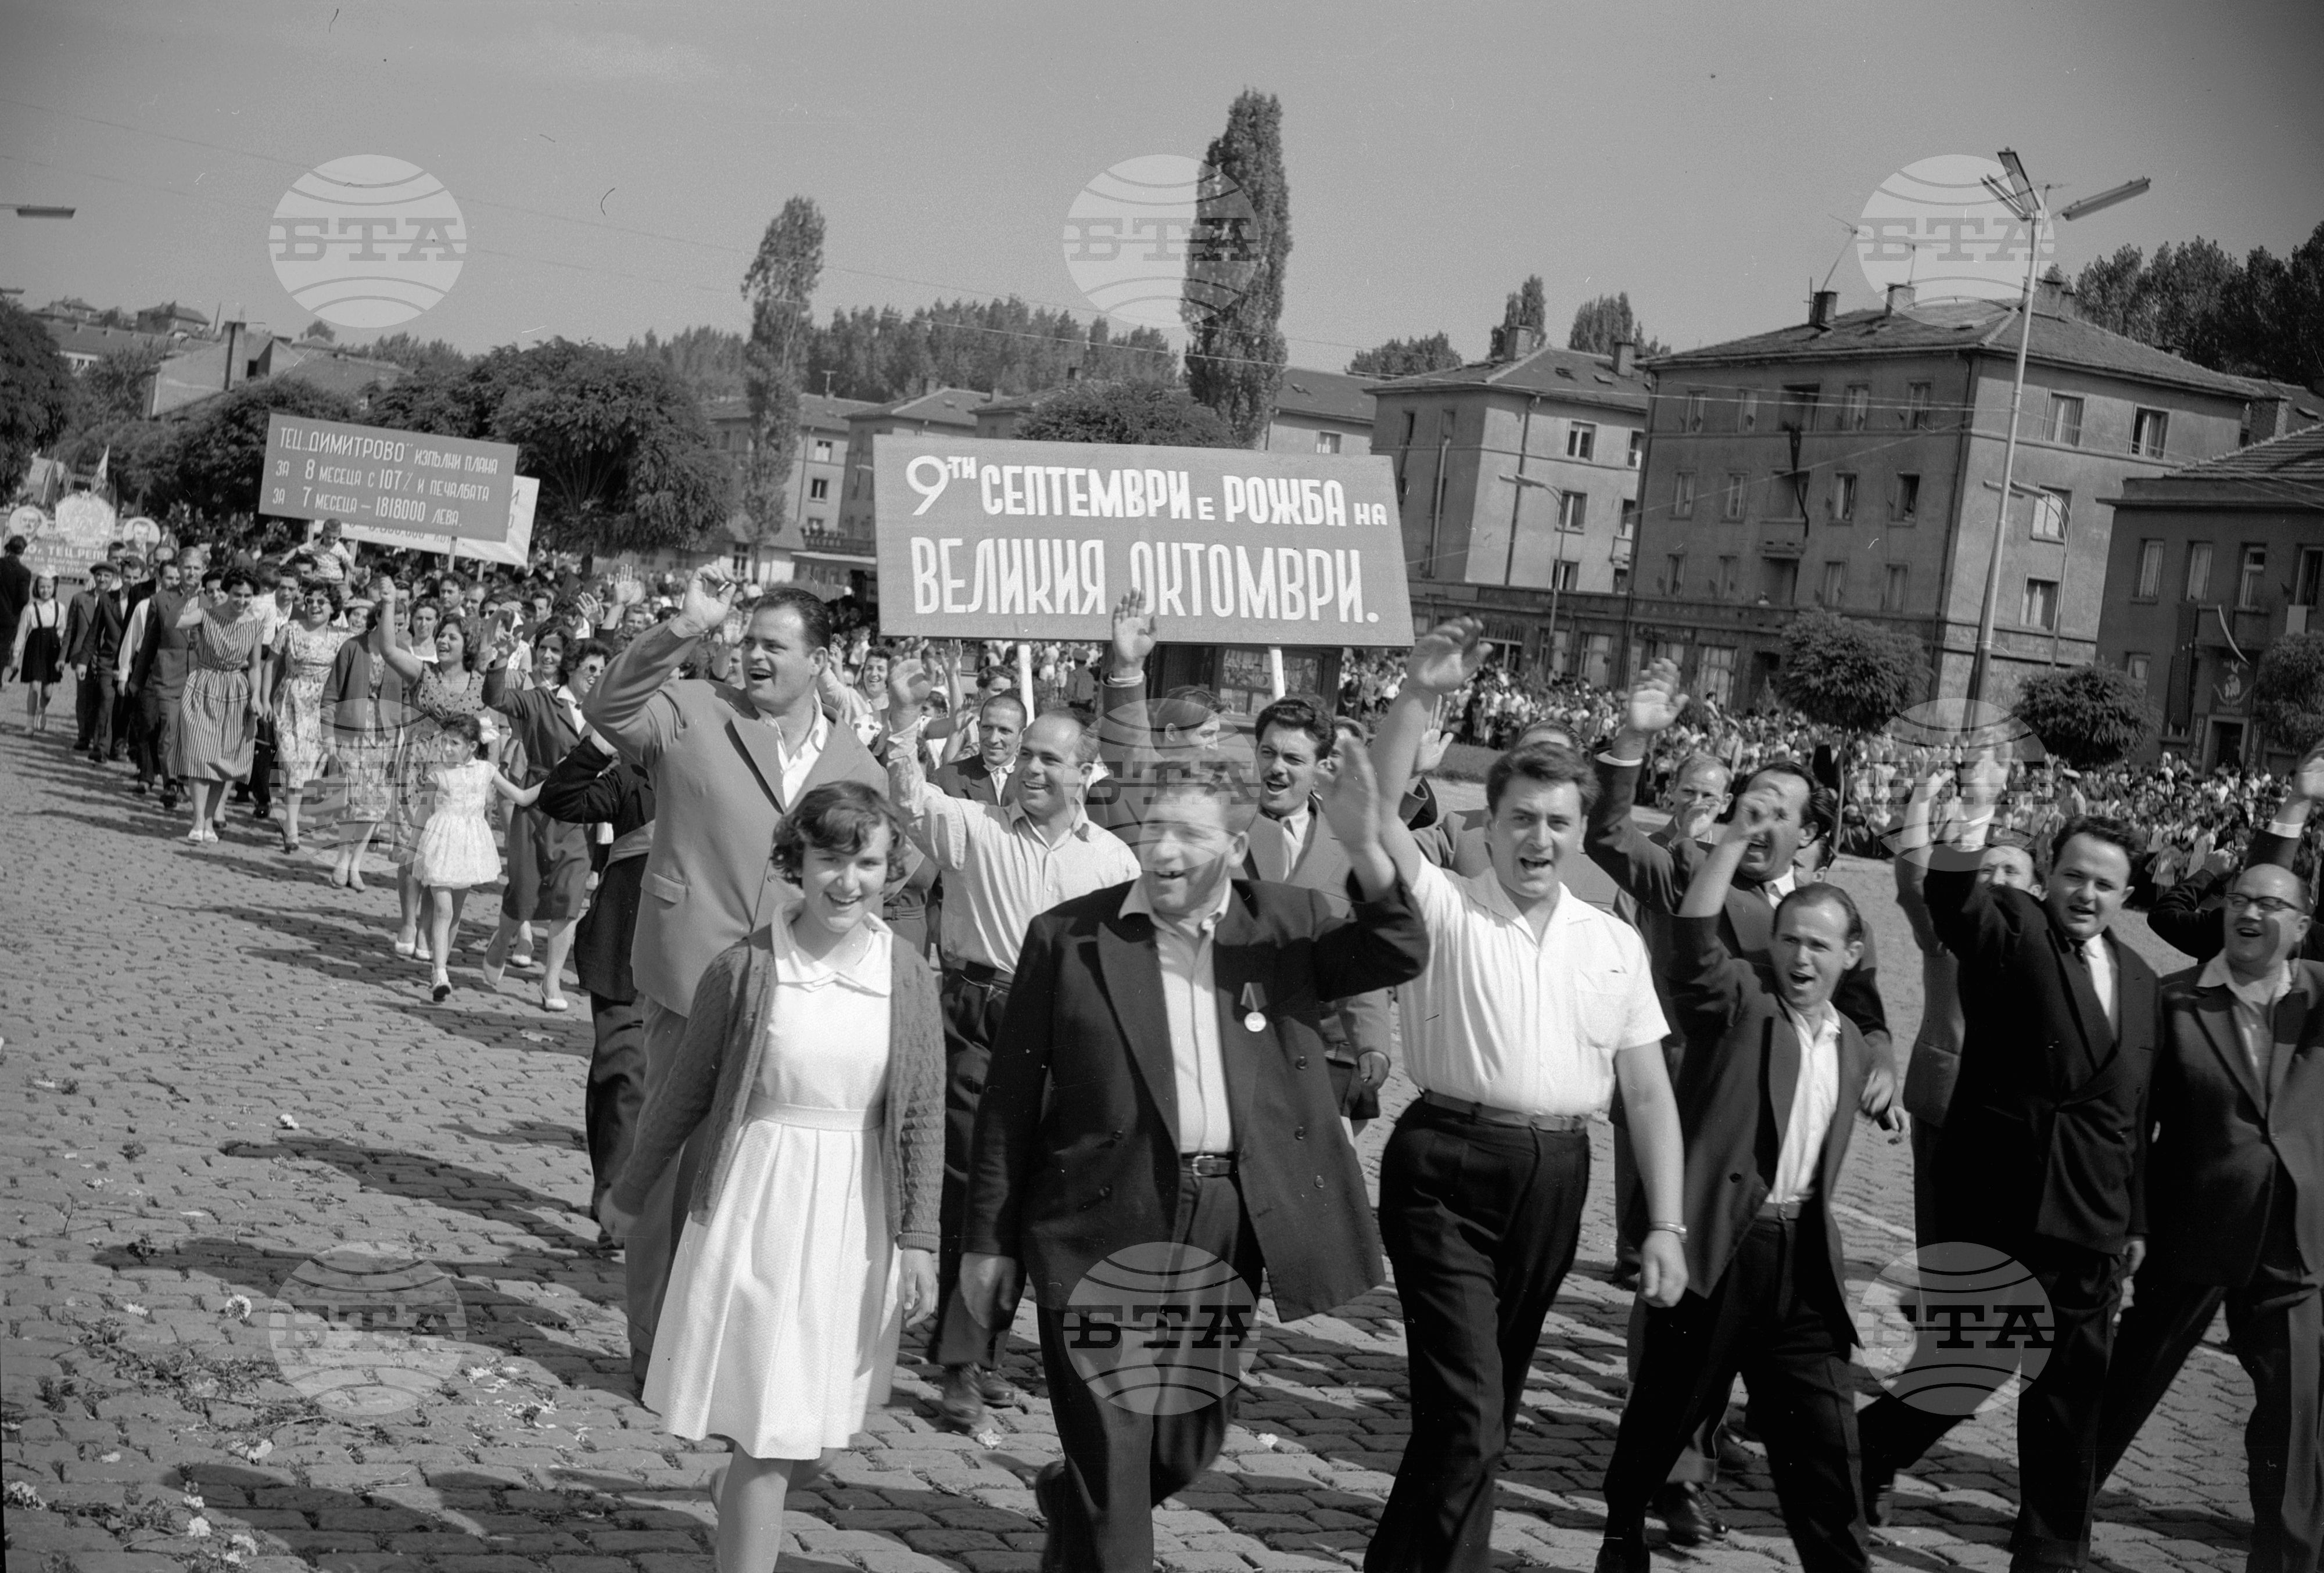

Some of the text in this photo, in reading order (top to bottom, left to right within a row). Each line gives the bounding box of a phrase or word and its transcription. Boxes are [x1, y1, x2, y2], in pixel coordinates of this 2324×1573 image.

[279, 427, 302, 450] ТЕЦ
[414, 448, 461, 470] ИЗПЪЛНИ
[464, 455, 498, 475] ПЛАНА
[276, 459, 289, 477] ЗА
[305, 458, 315, 480] 8
[319, 465, 362, 486] МЕСЕЦА
[368, 471, 375, 488] С
[417, 478, 425, 494] И
[429, 479, 490, 502] ПЕЧАЛБАТА
[980, 464, 1192, 519] СЕПТЕМВРИ
[1197, 497, 1215, 520] Е
[1222, 475, 1347, 527] РОЖБА
[1354, 502, 1387, 525] НА
[272, 487, 285, 505] ЗА
[303, 486, 313, 508] 7
[314, 493, 358, 513] МЕСЕЦА
[375, 495, 426, 522] 1818000
[431, 508, 462, 528] ЛЕВА.
[910, 537, 1379, 623] ВЕЛИКИЯ ОКТОМВРИ.
